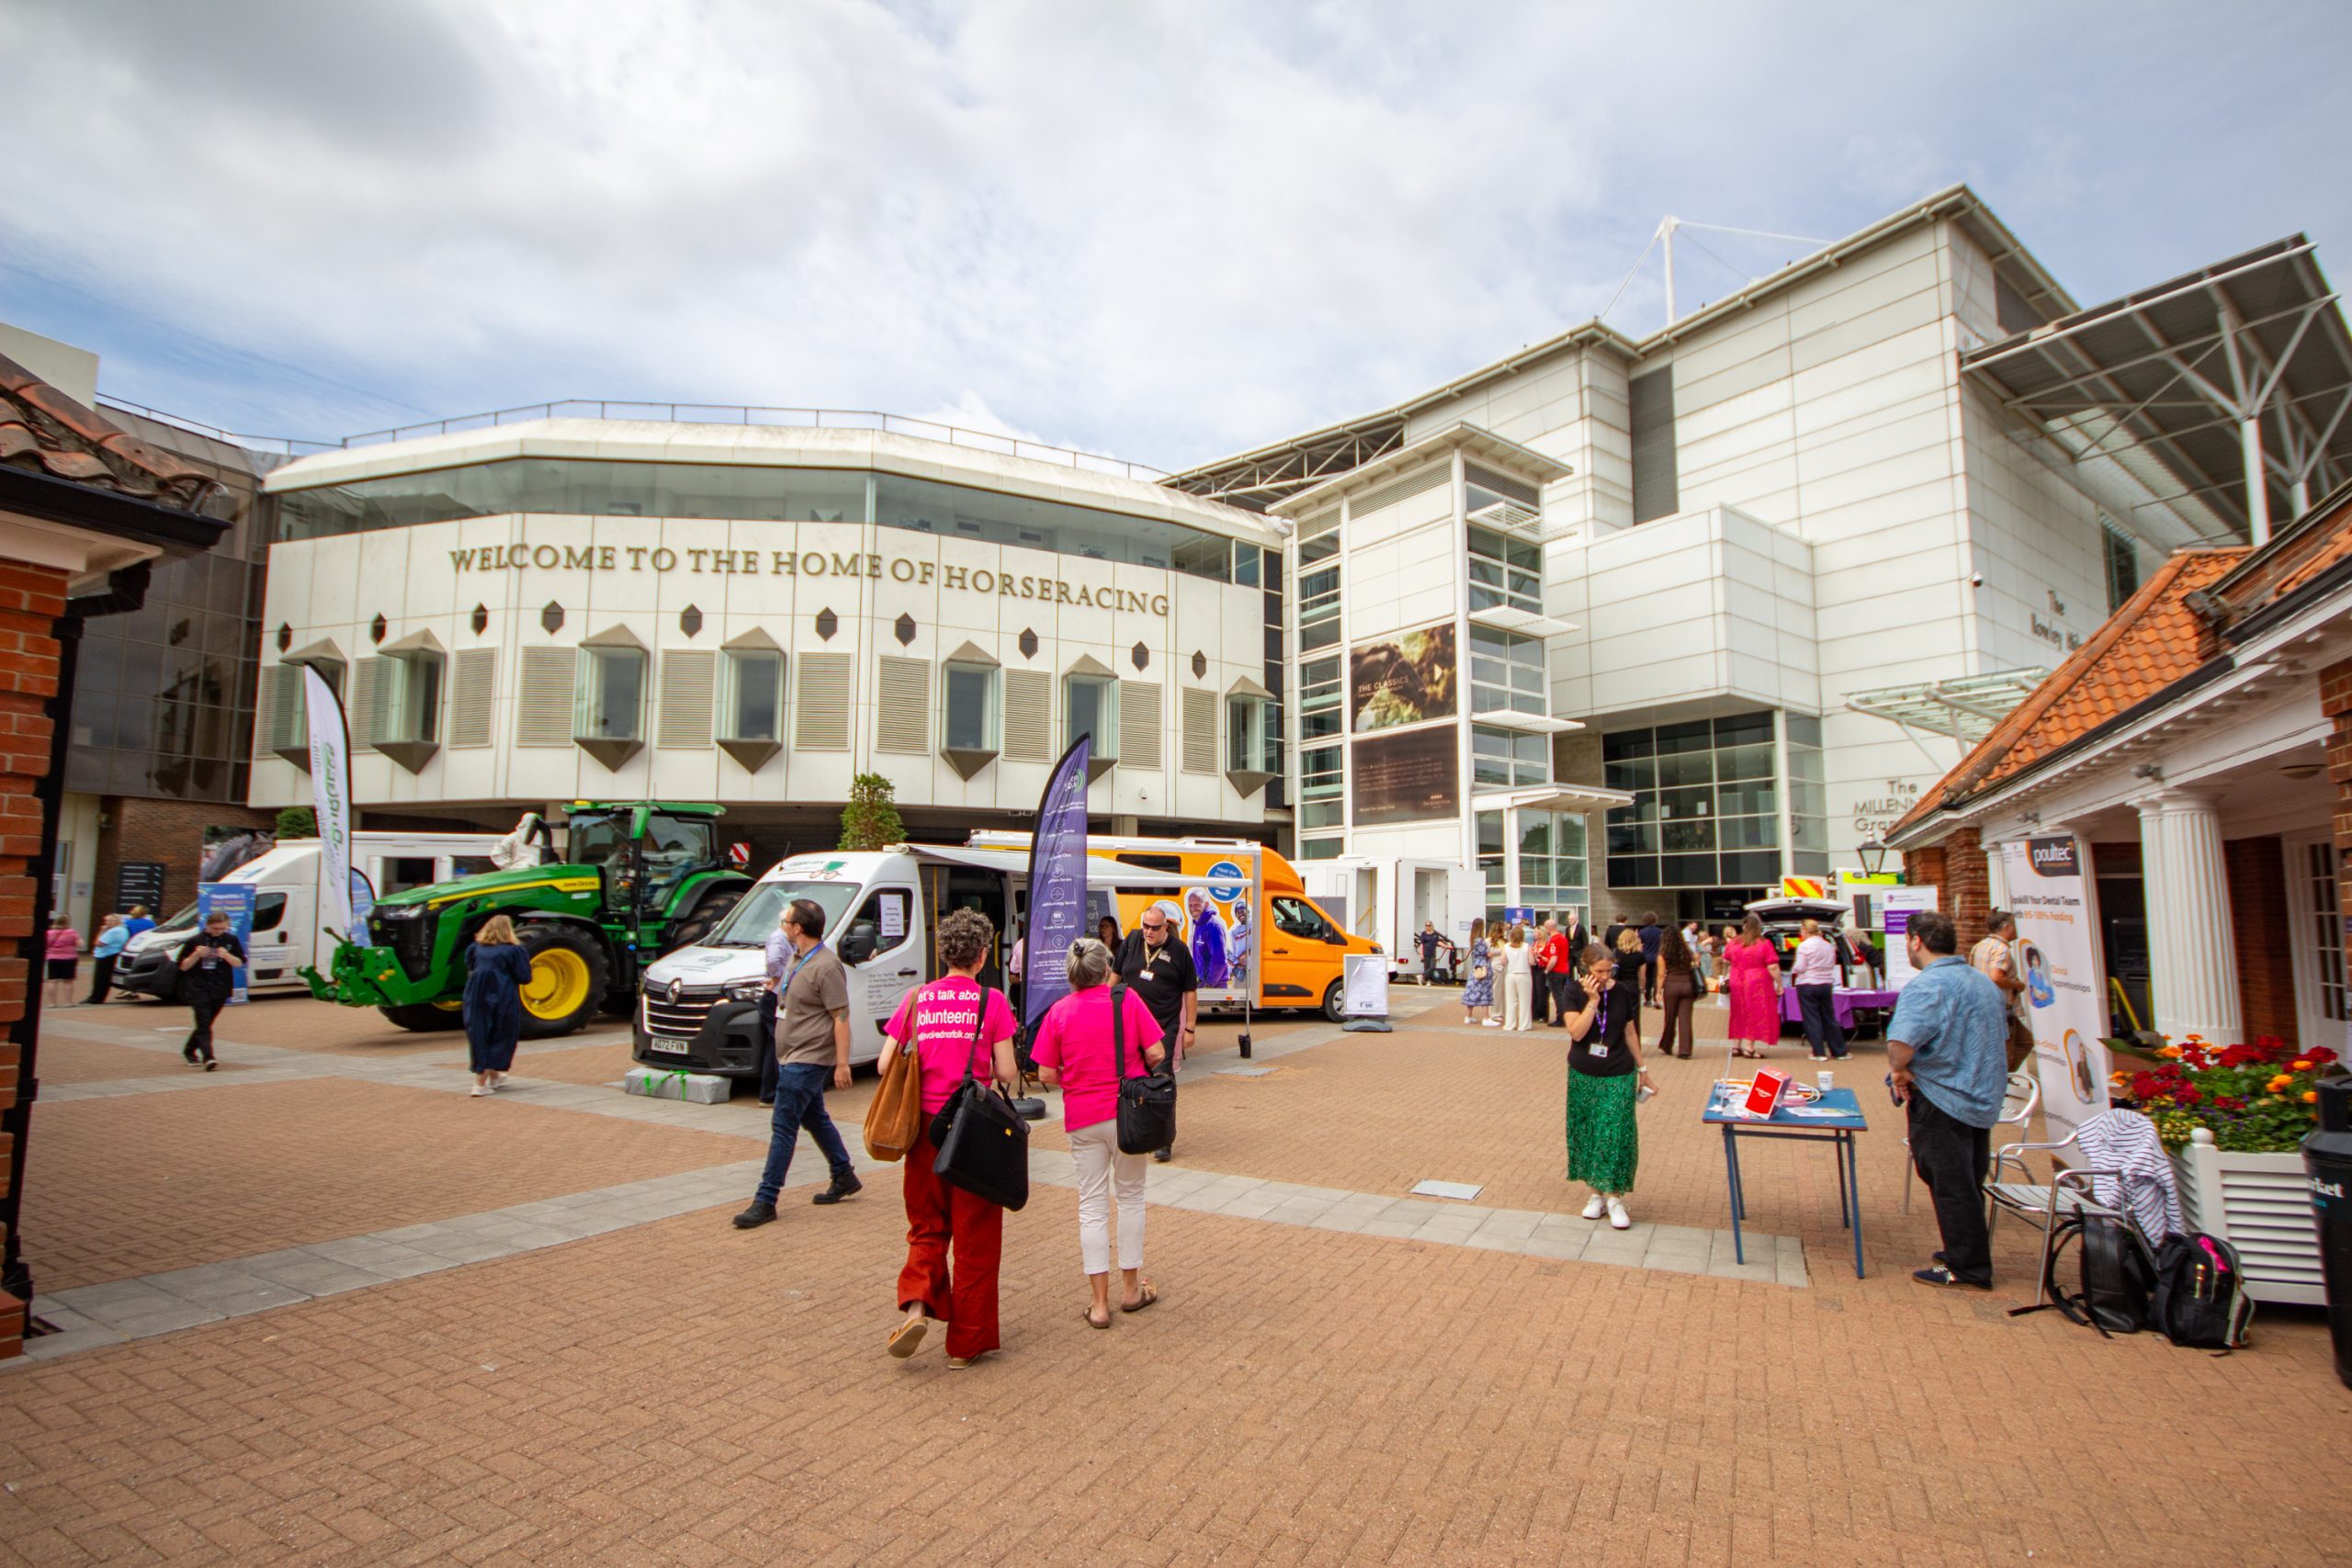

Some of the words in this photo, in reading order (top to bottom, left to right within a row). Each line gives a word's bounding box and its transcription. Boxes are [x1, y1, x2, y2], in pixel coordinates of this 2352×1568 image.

[448, 543, 616, 574] WELCOME
[627, 546, 677, 573] TO
[688, 548, 759, 574] THE
[772, 551, 882, 579] HOME
[890, 558, 935, 585] OF
[944, 566, 1170, 617] HORSERACING
[1358, 683, 1372, 694] THE
[1374, 675, 1409, 690] CLASSICS
[1887, 779, 1917, 795] The
[2033, 842, 2073, 868] poultec
[2061, 896, 2080, 907] Team
[917, 990, 934, 1003] et's
[937, 989, 956, 1001] talk
[958, 990, 980, 1001] abo
[916, 1009, 984, 1029] olunteerin
